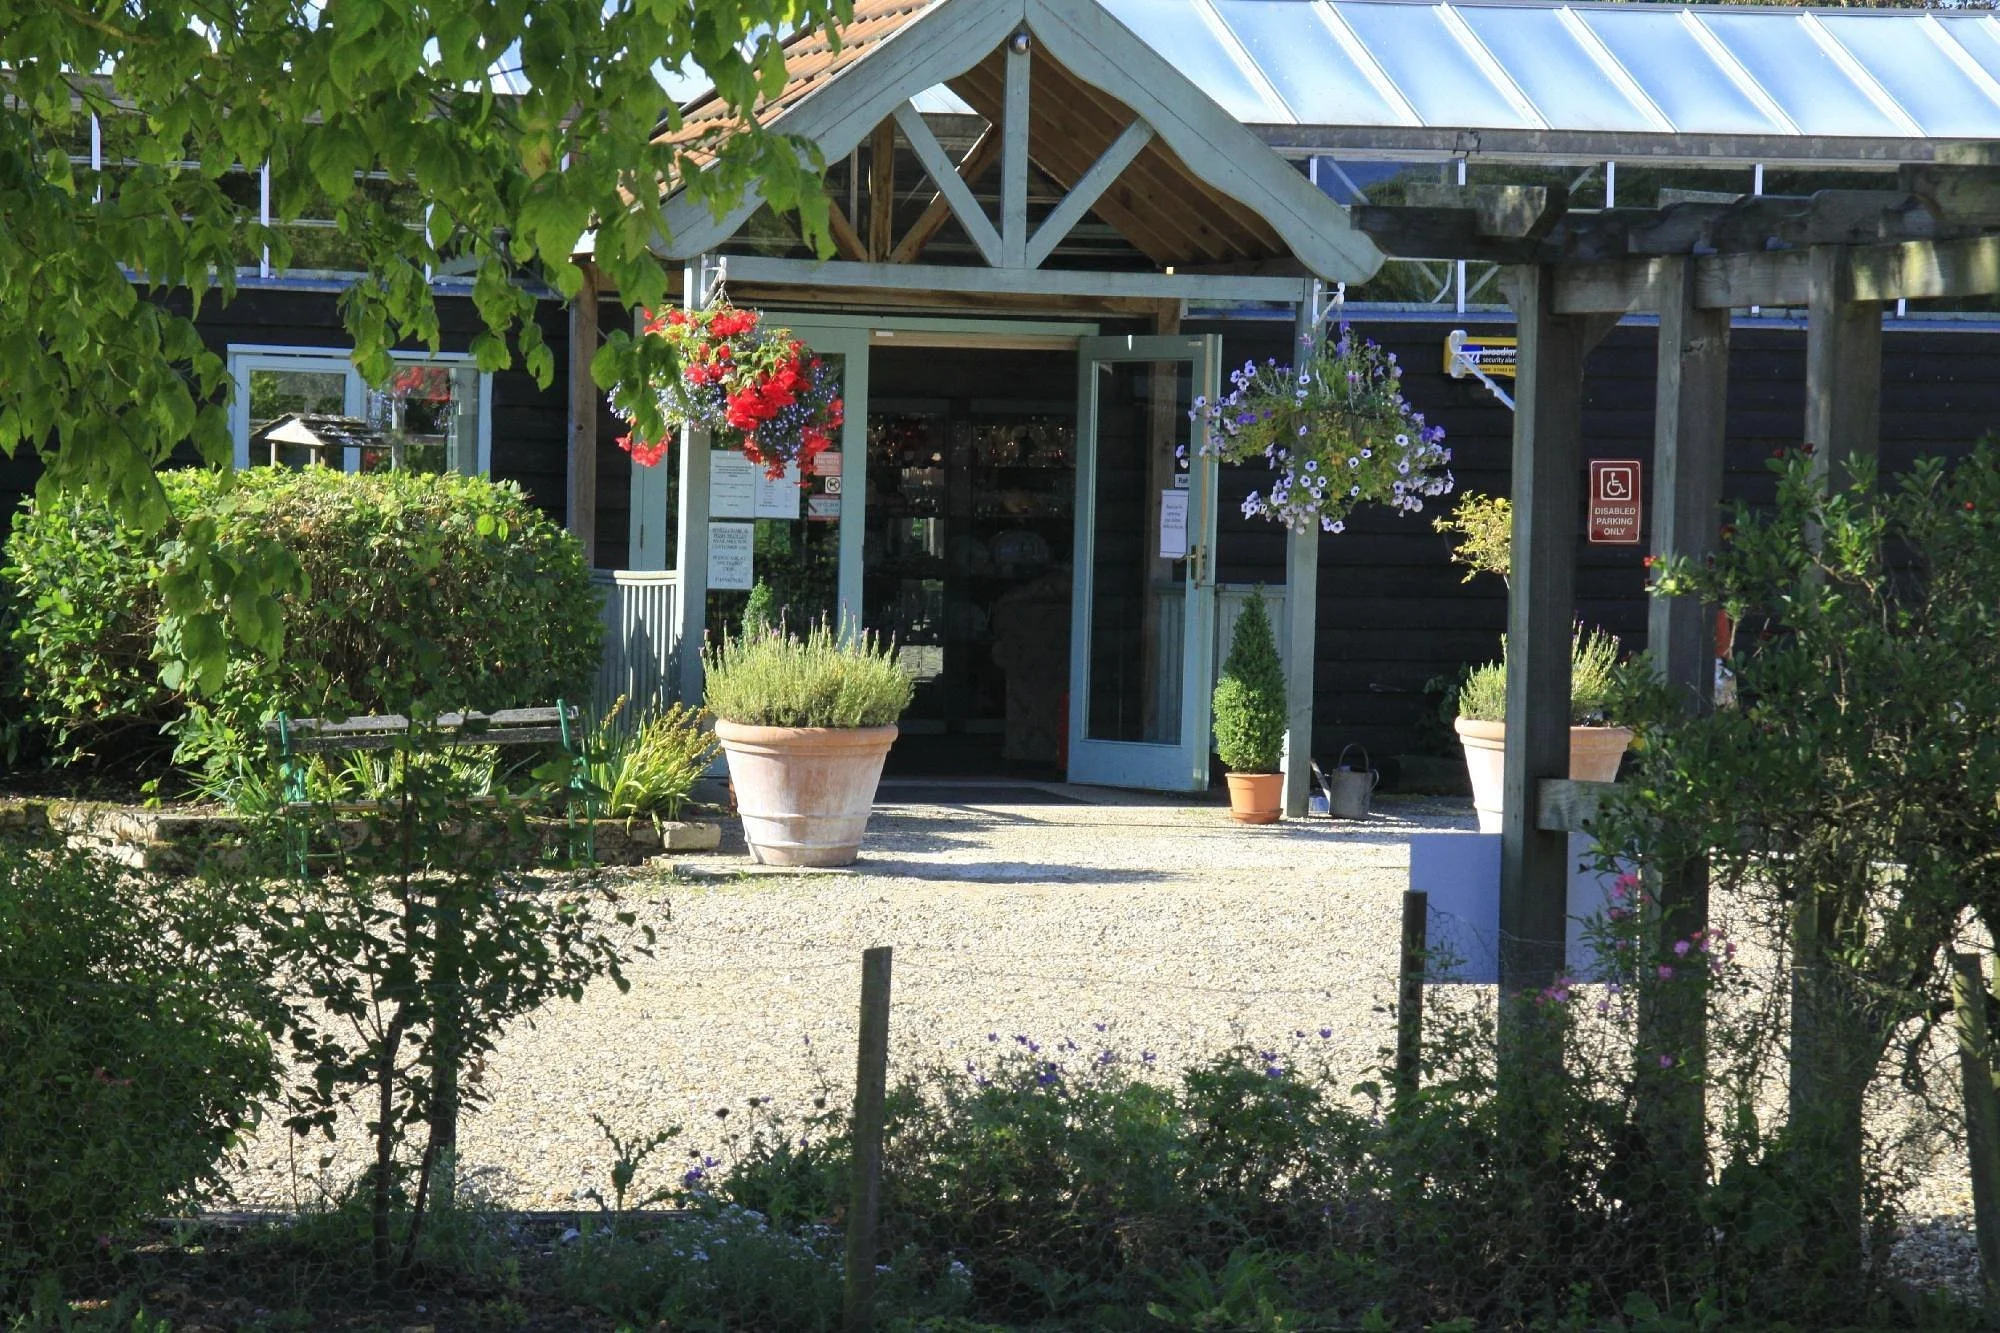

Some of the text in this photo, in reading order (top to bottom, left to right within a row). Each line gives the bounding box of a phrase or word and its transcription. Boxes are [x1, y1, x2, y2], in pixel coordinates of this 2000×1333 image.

[1482, 357, 1504, 365] security
[1594, 507, 1636, 515] DISABLED
[1596, 517, 1633, 525] PARKING
[1603, 527, 1626, 536] ONLY
